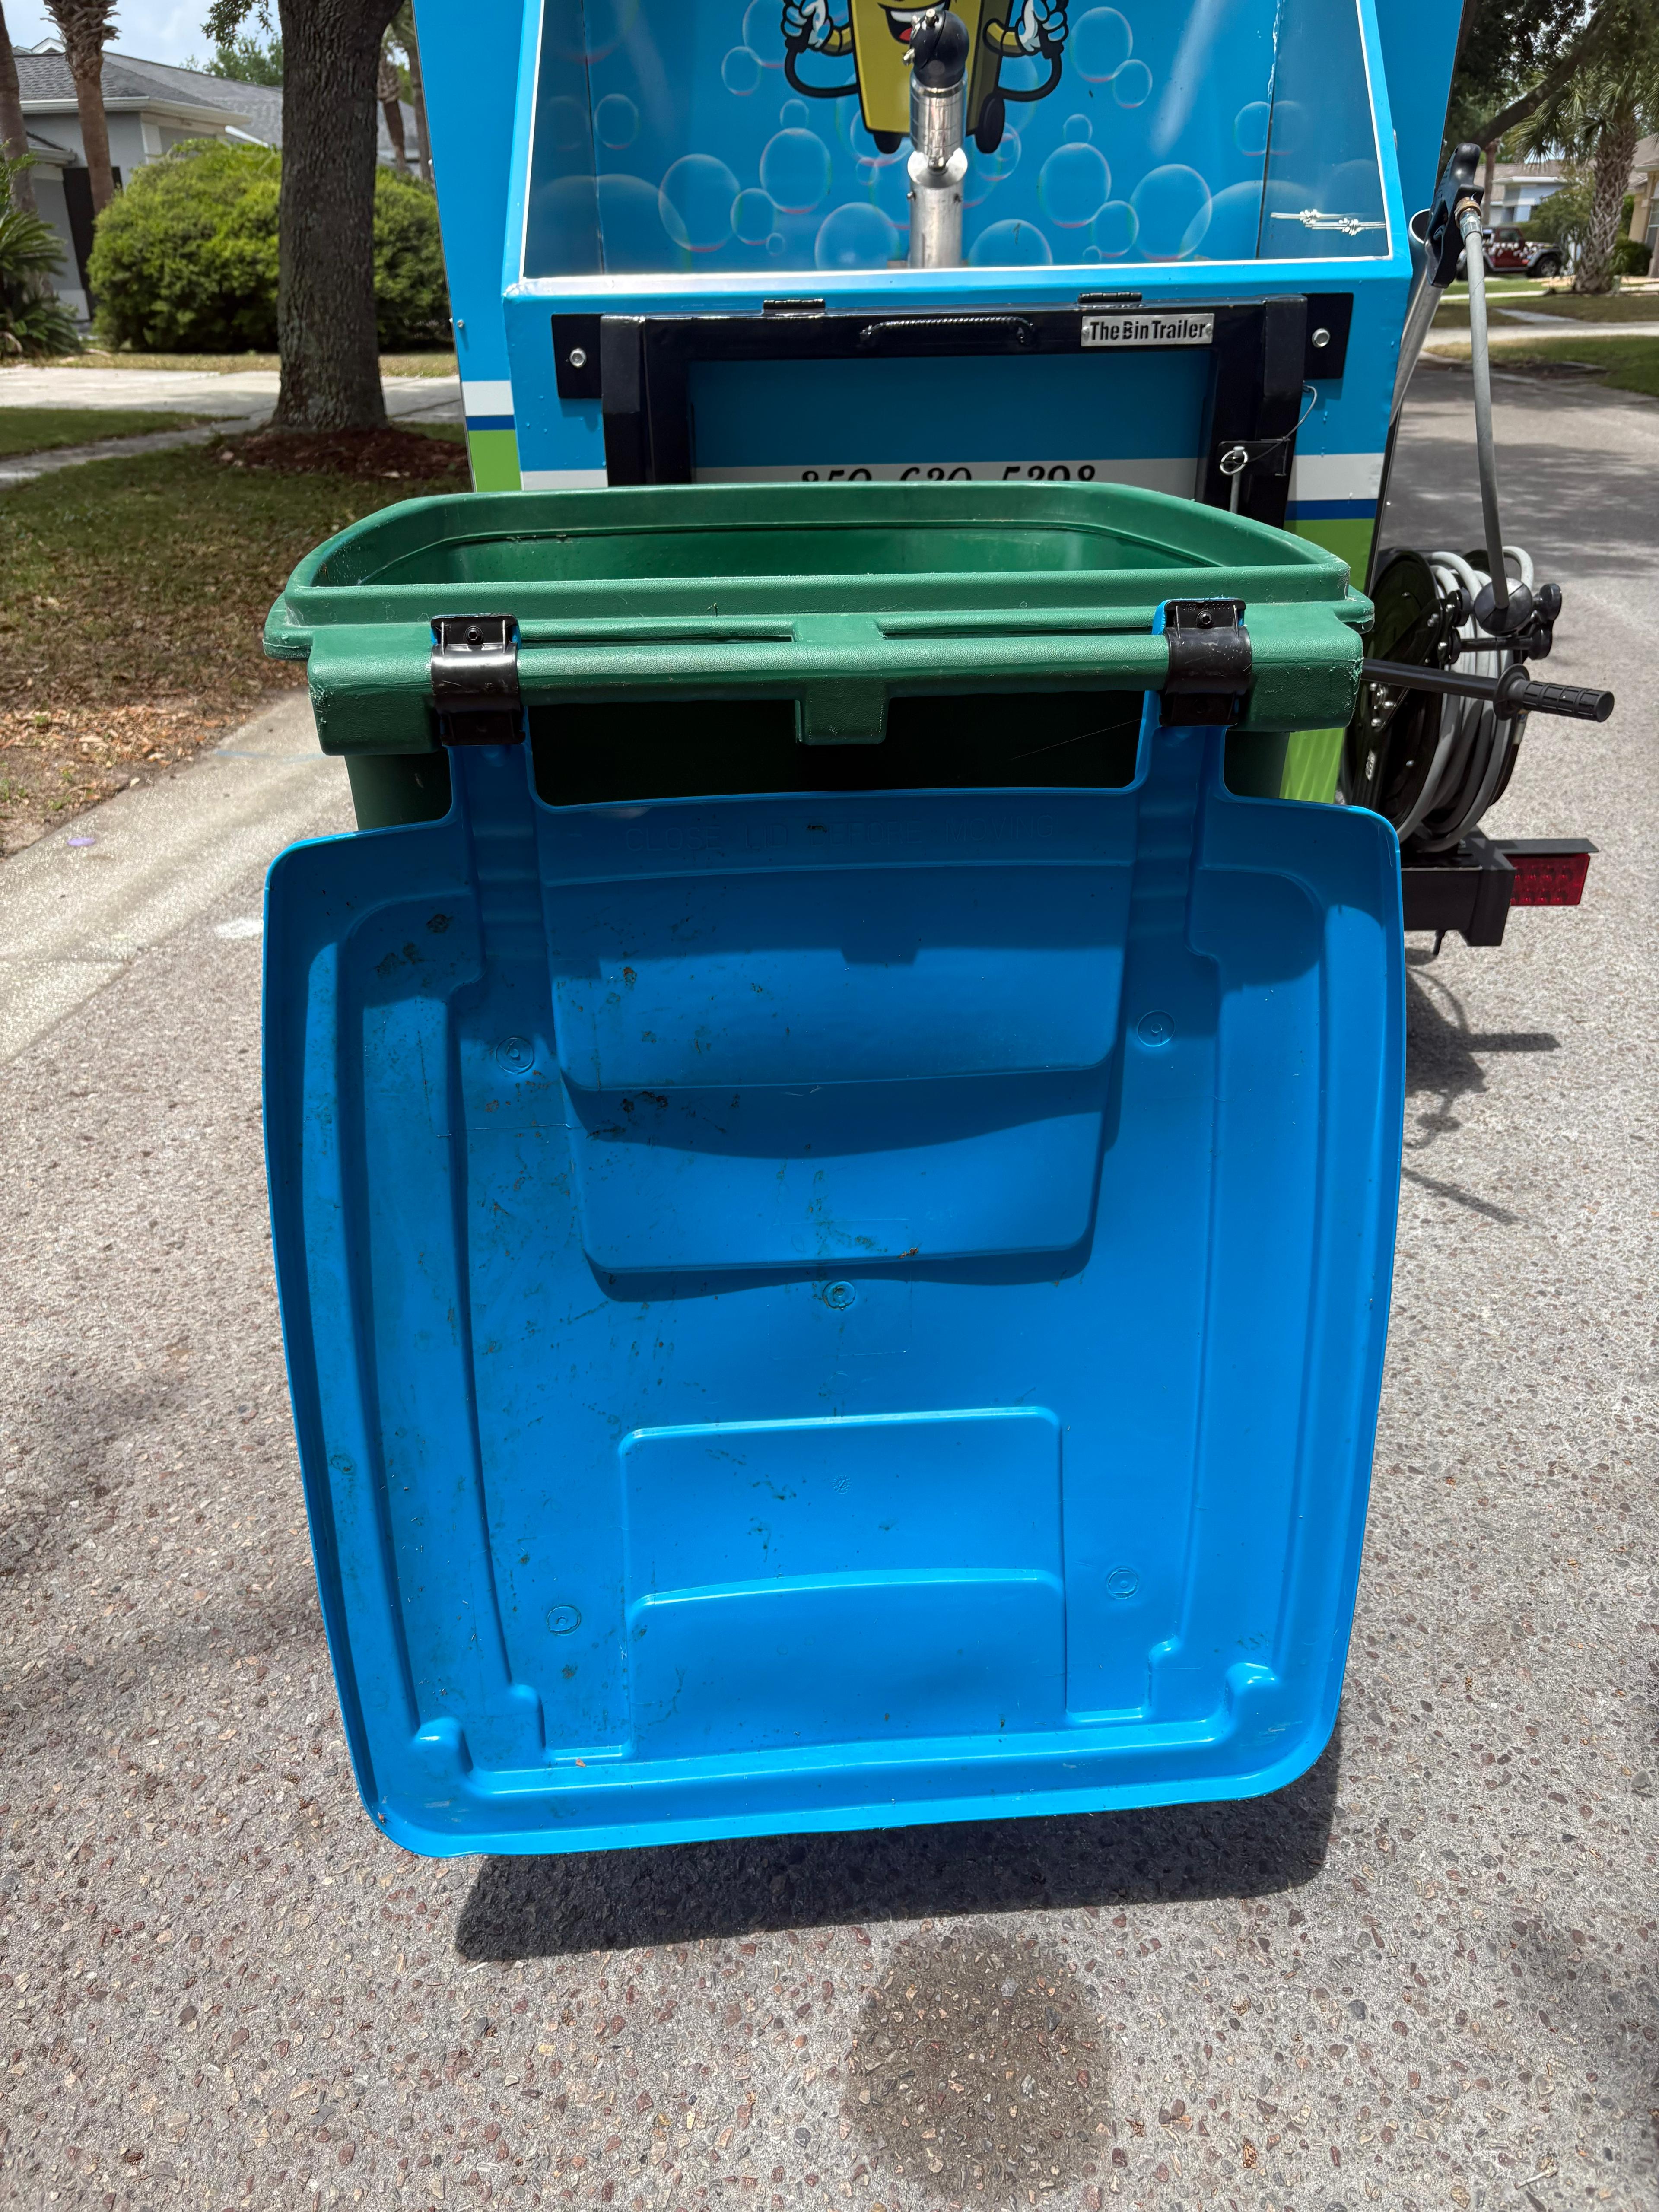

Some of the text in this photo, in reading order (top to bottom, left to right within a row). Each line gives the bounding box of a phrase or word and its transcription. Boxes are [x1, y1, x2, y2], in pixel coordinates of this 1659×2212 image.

[1089, 320, 1207, 340] The Bin Trailer
[626, 825, 721, 851] CLOSE
[744, 823, 788, 849] LID
[945, 814, 1055, 843] MOVING
